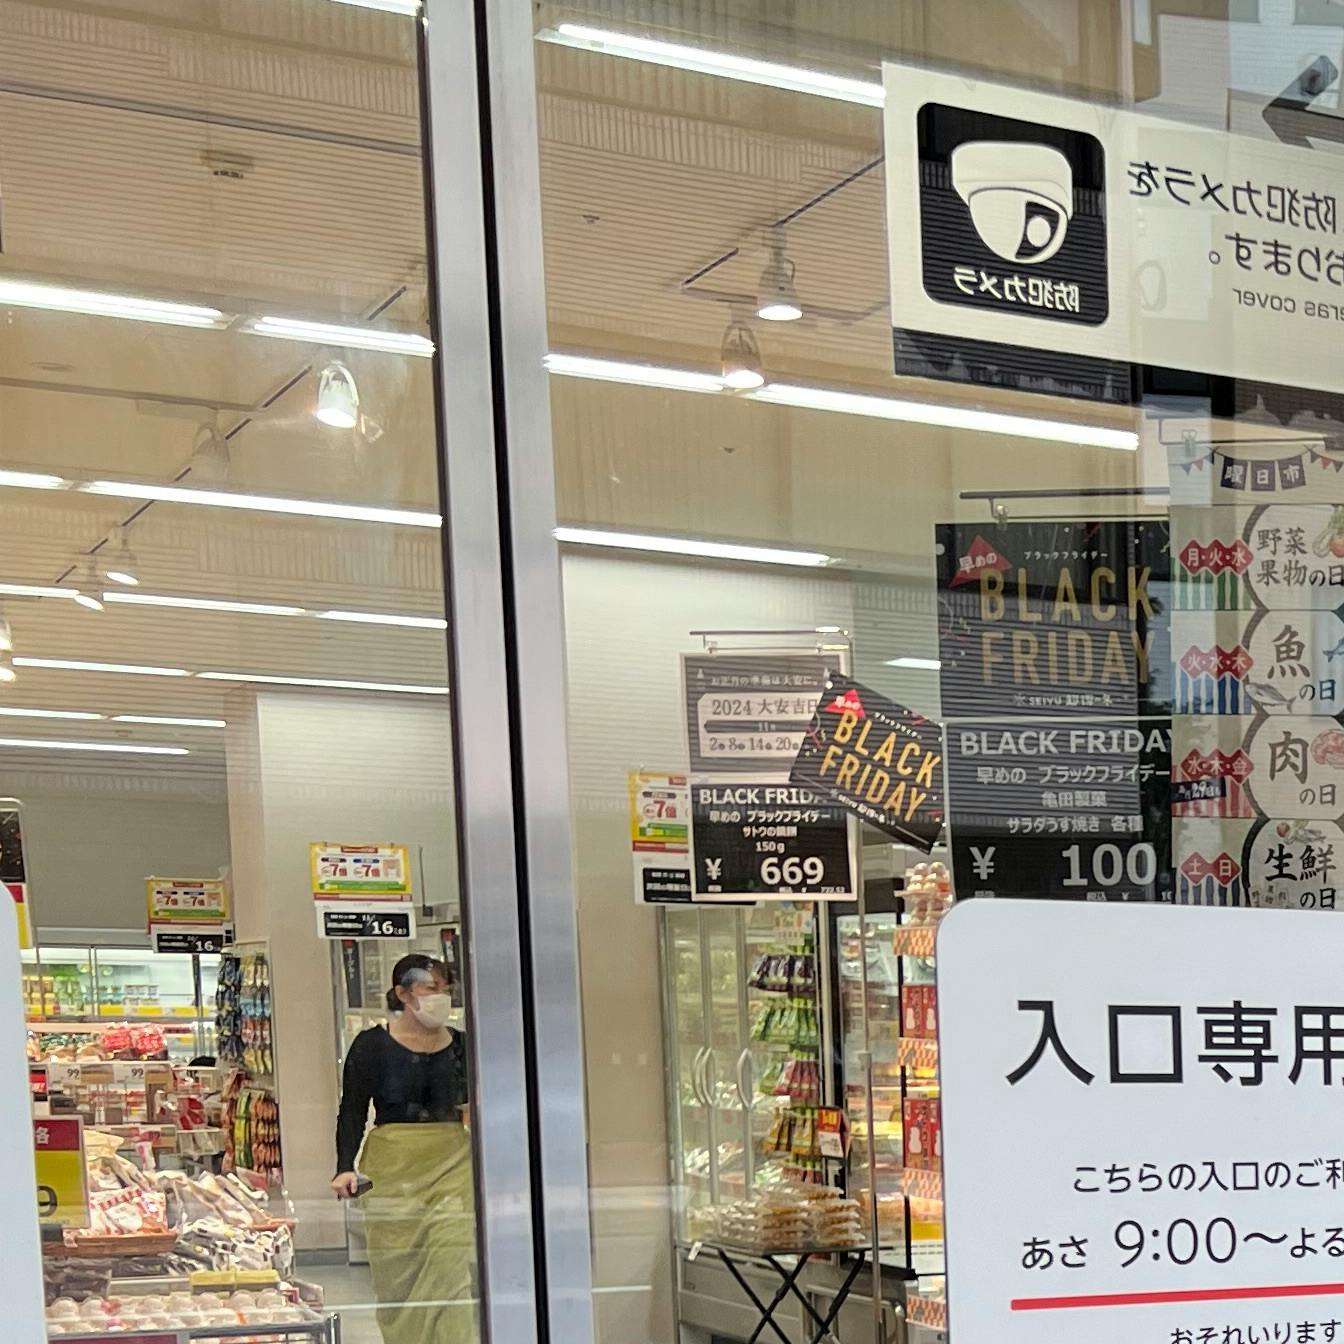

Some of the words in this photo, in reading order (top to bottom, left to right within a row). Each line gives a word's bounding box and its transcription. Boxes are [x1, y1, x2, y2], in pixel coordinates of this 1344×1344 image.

[1224, 464, 1302, 485] 曜日市
[1256, 526, 1308, 557] 野菜
[980, 565, 1155, 623] BLACK
[981, 630, 1156, 686] FRIDAY
[1266, 624, 1311, 680] 魚
[1299, 678, 1337, 704] の日
[711, 699, 752, 716] 2024
[833, 710, 941, 789] BLACK
[960, 729, 1060, 756] BLACK
[1267, 730, 1310, 785] 肉
[819, 744, 927, 823] FRIDAY
[976, 766, 1027, 786] 早めの
[1039, 763, 1170, 785] ブラックフライデー
[700, 788, 760, 805] BLACK
[1299, 783, 1337, 806] の日
[705, 858, 722, 881] ¥
[760, 856, 825, 886] 669
[968, 846, 996, 881] ¥
[1061, 842, 1158, 887] 100
[1264, 843, 1337, 884] 生鮮
[1299, 887, 1337, 910] の日
[1020, 1231, 1090, 1272] あさ
